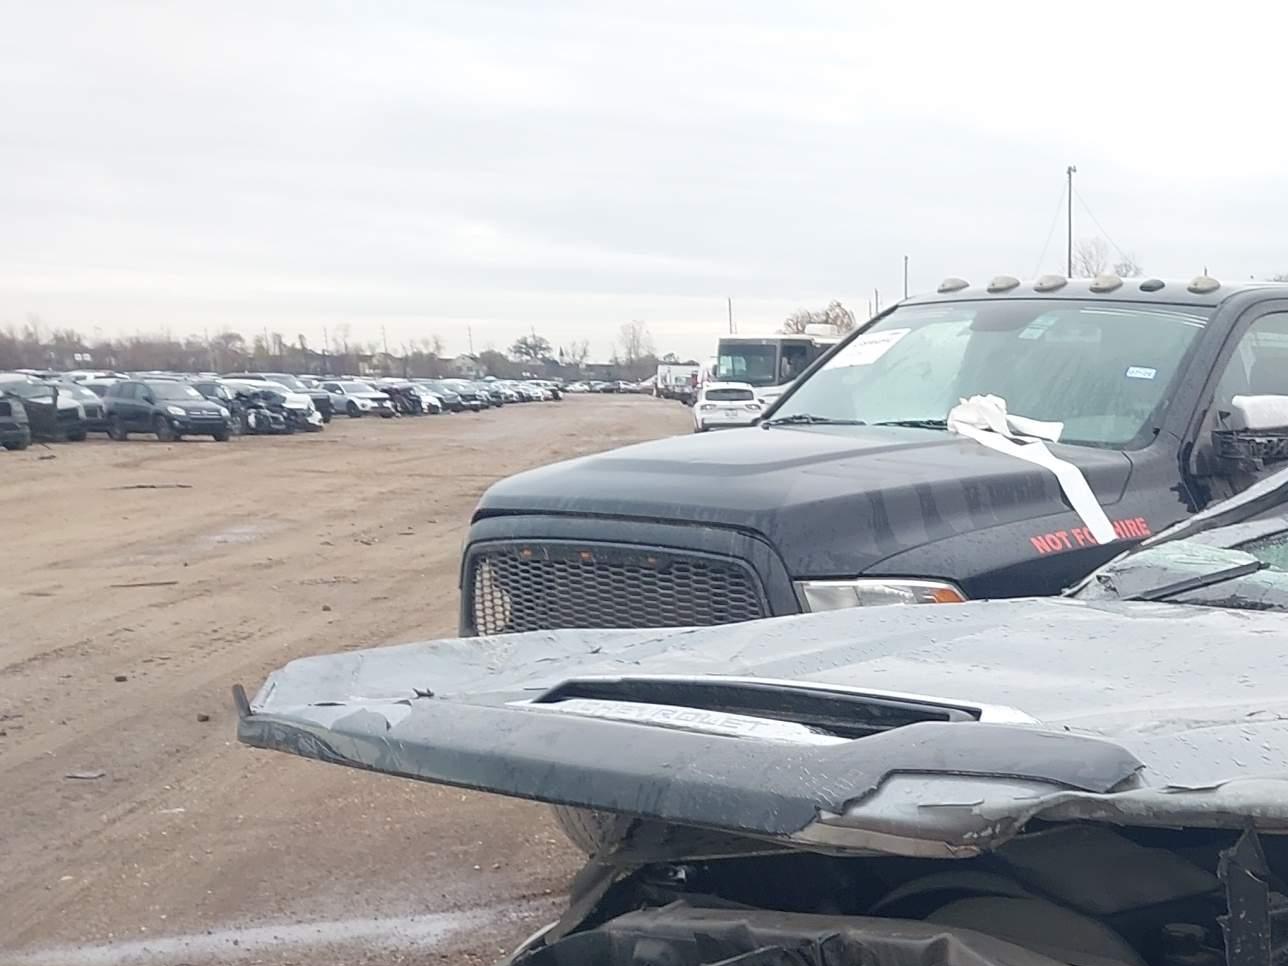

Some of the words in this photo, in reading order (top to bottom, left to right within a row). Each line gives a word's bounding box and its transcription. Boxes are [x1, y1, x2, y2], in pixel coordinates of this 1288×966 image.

[1031, 531, 1073, 553] NOT
[1072, 526, 1099, 546] FO
[577, 701, 769, 731] CHEVROLET
